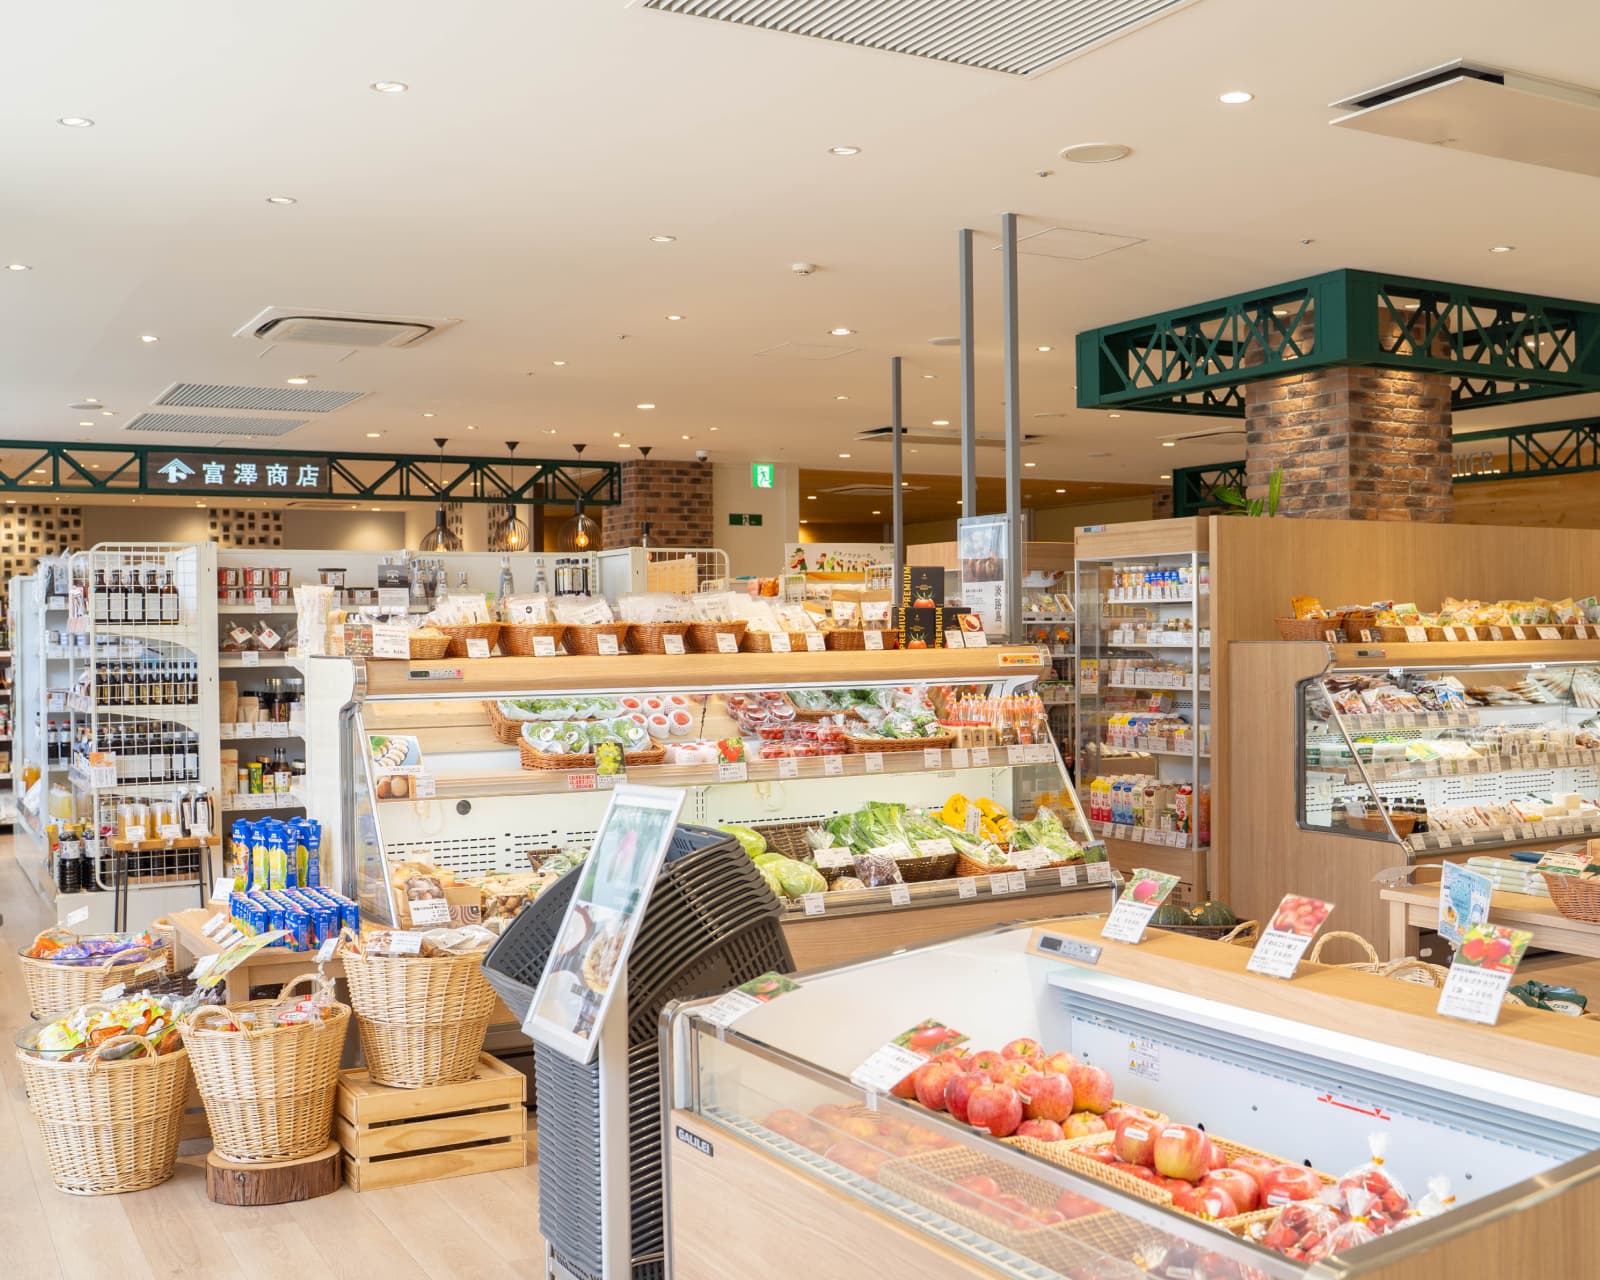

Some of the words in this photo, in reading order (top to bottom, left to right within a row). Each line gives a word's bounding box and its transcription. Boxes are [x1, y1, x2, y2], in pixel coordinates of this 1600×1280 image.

[202, 461, 319, 487] 富澤商店
[903, 566, 911, 608] PREMIUM
[898, 608, 906, 649] PREMIUM
[935, 608, 943, 649] PREMIUM
[678, 1129, 710, 1153] GALILEI
